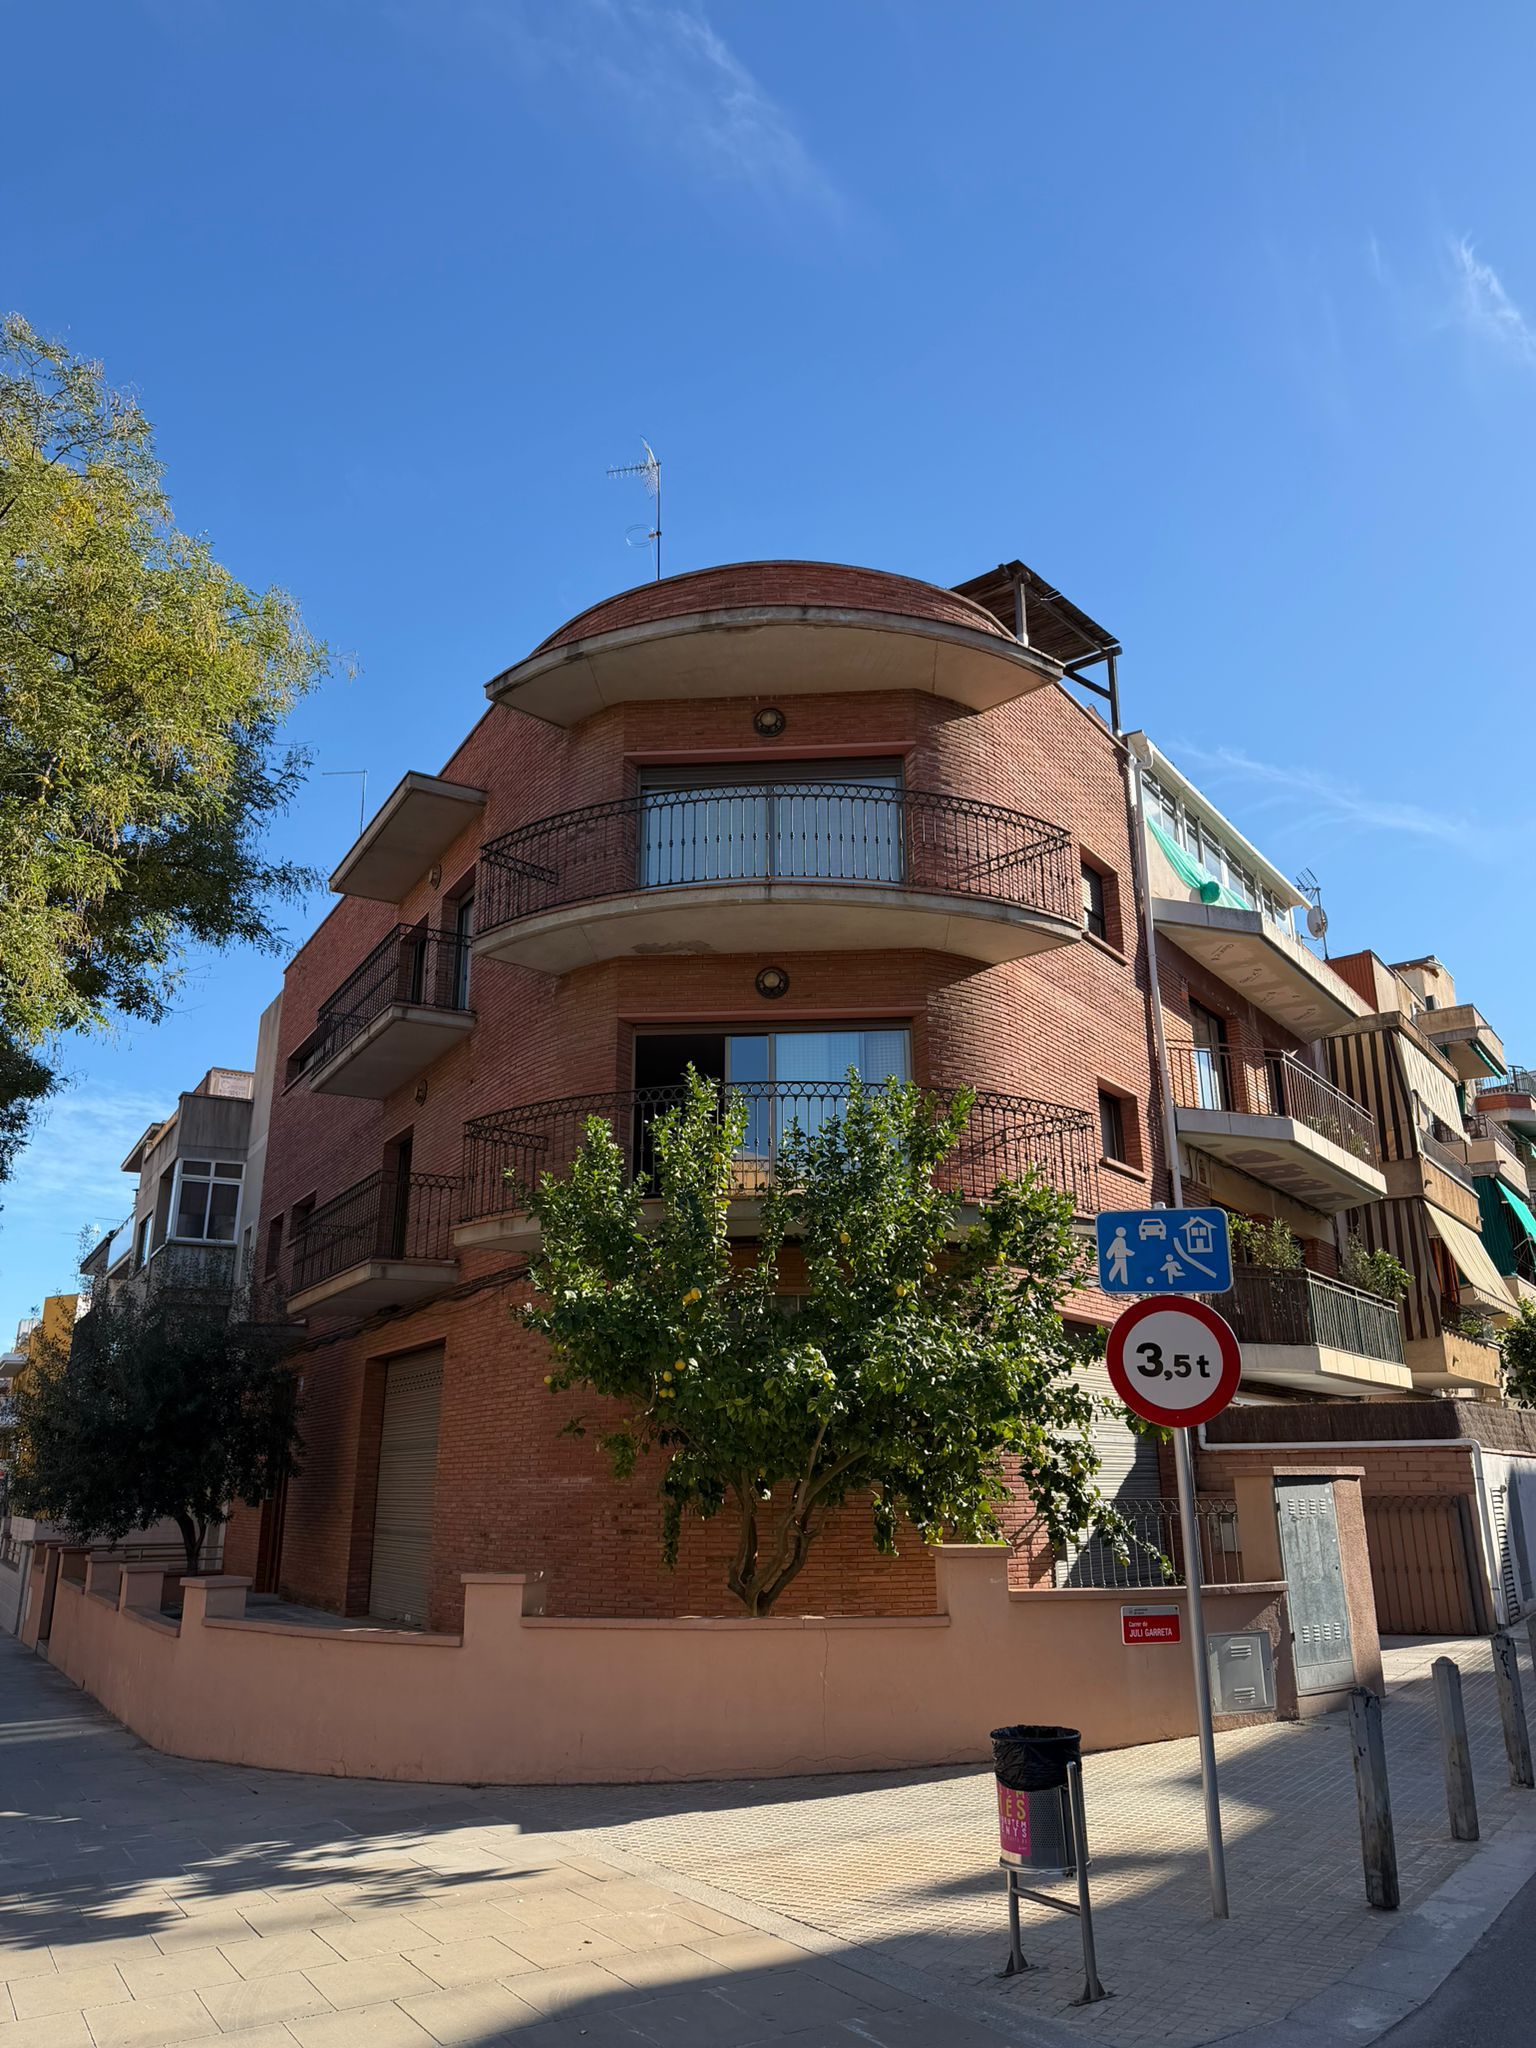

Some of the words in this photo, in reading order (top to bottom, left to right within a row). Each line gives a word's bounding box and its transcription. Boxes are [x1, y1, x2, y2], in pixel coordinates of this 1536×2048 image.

[1136, 1342, 1192, 1380] 3,5
[1197, 1354, 1210, 1378] t
[1129, 1628, 1143, 1637] JULI
[1144, 1627, 1173, 1637] GARRETA
